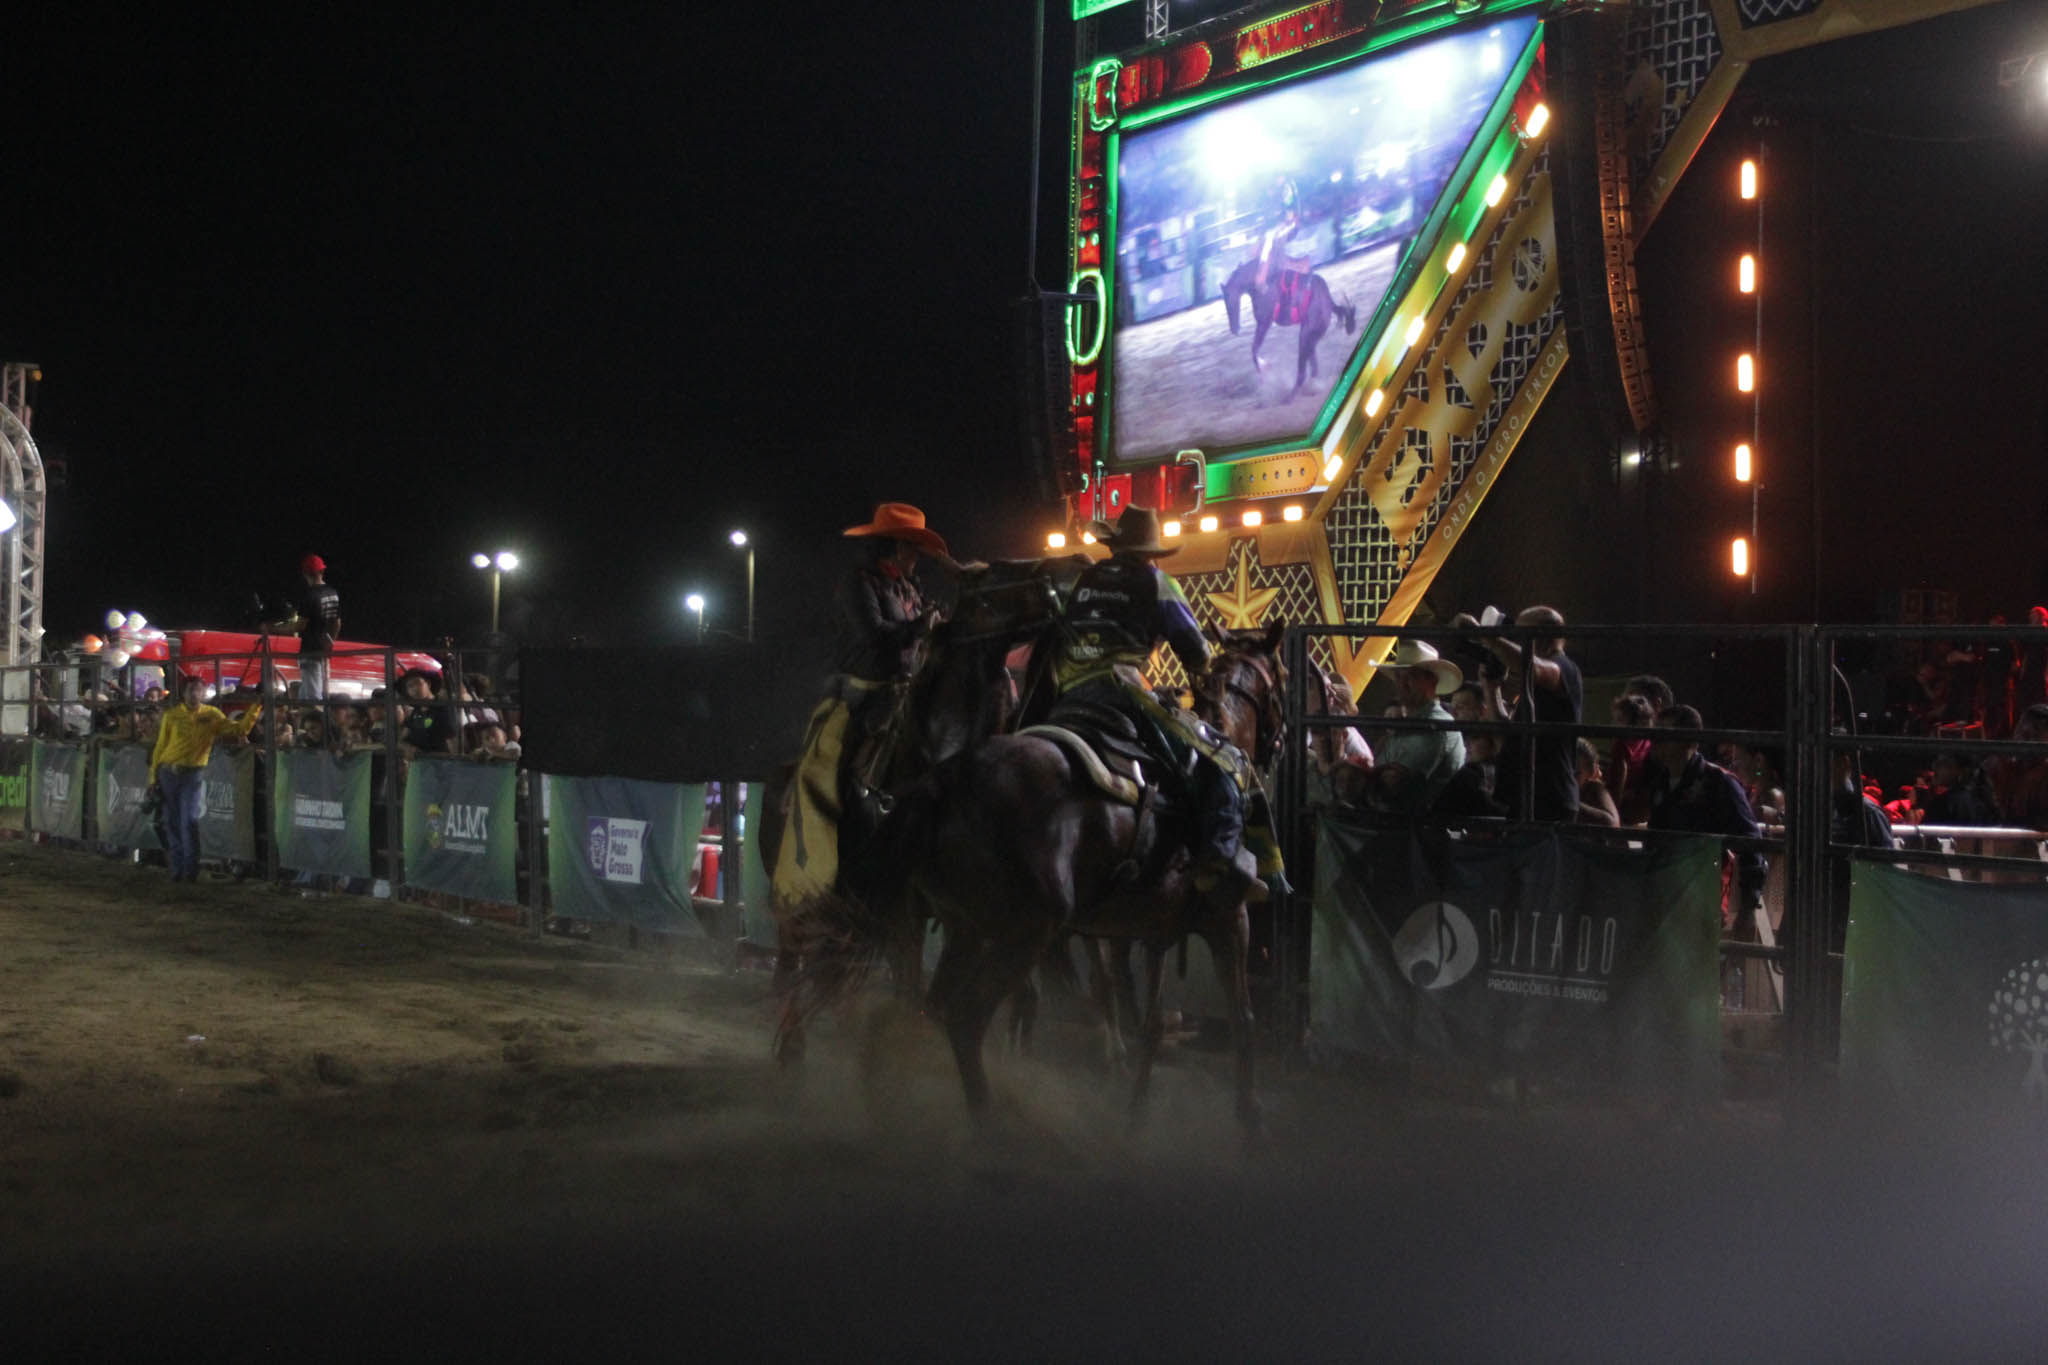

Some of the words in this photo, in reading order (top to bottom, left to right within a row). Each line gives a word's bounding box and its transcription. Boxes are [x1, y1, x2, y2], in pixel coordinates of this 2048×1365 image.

[1442, 493, 1475, 541] ONDE
[1475, 471, 1487, 486] O
[1525, 329, 1566, 405] ENCON
[444, 804, 489, 840] ALMT
[1488, 907, 1617, 975] DITADO
